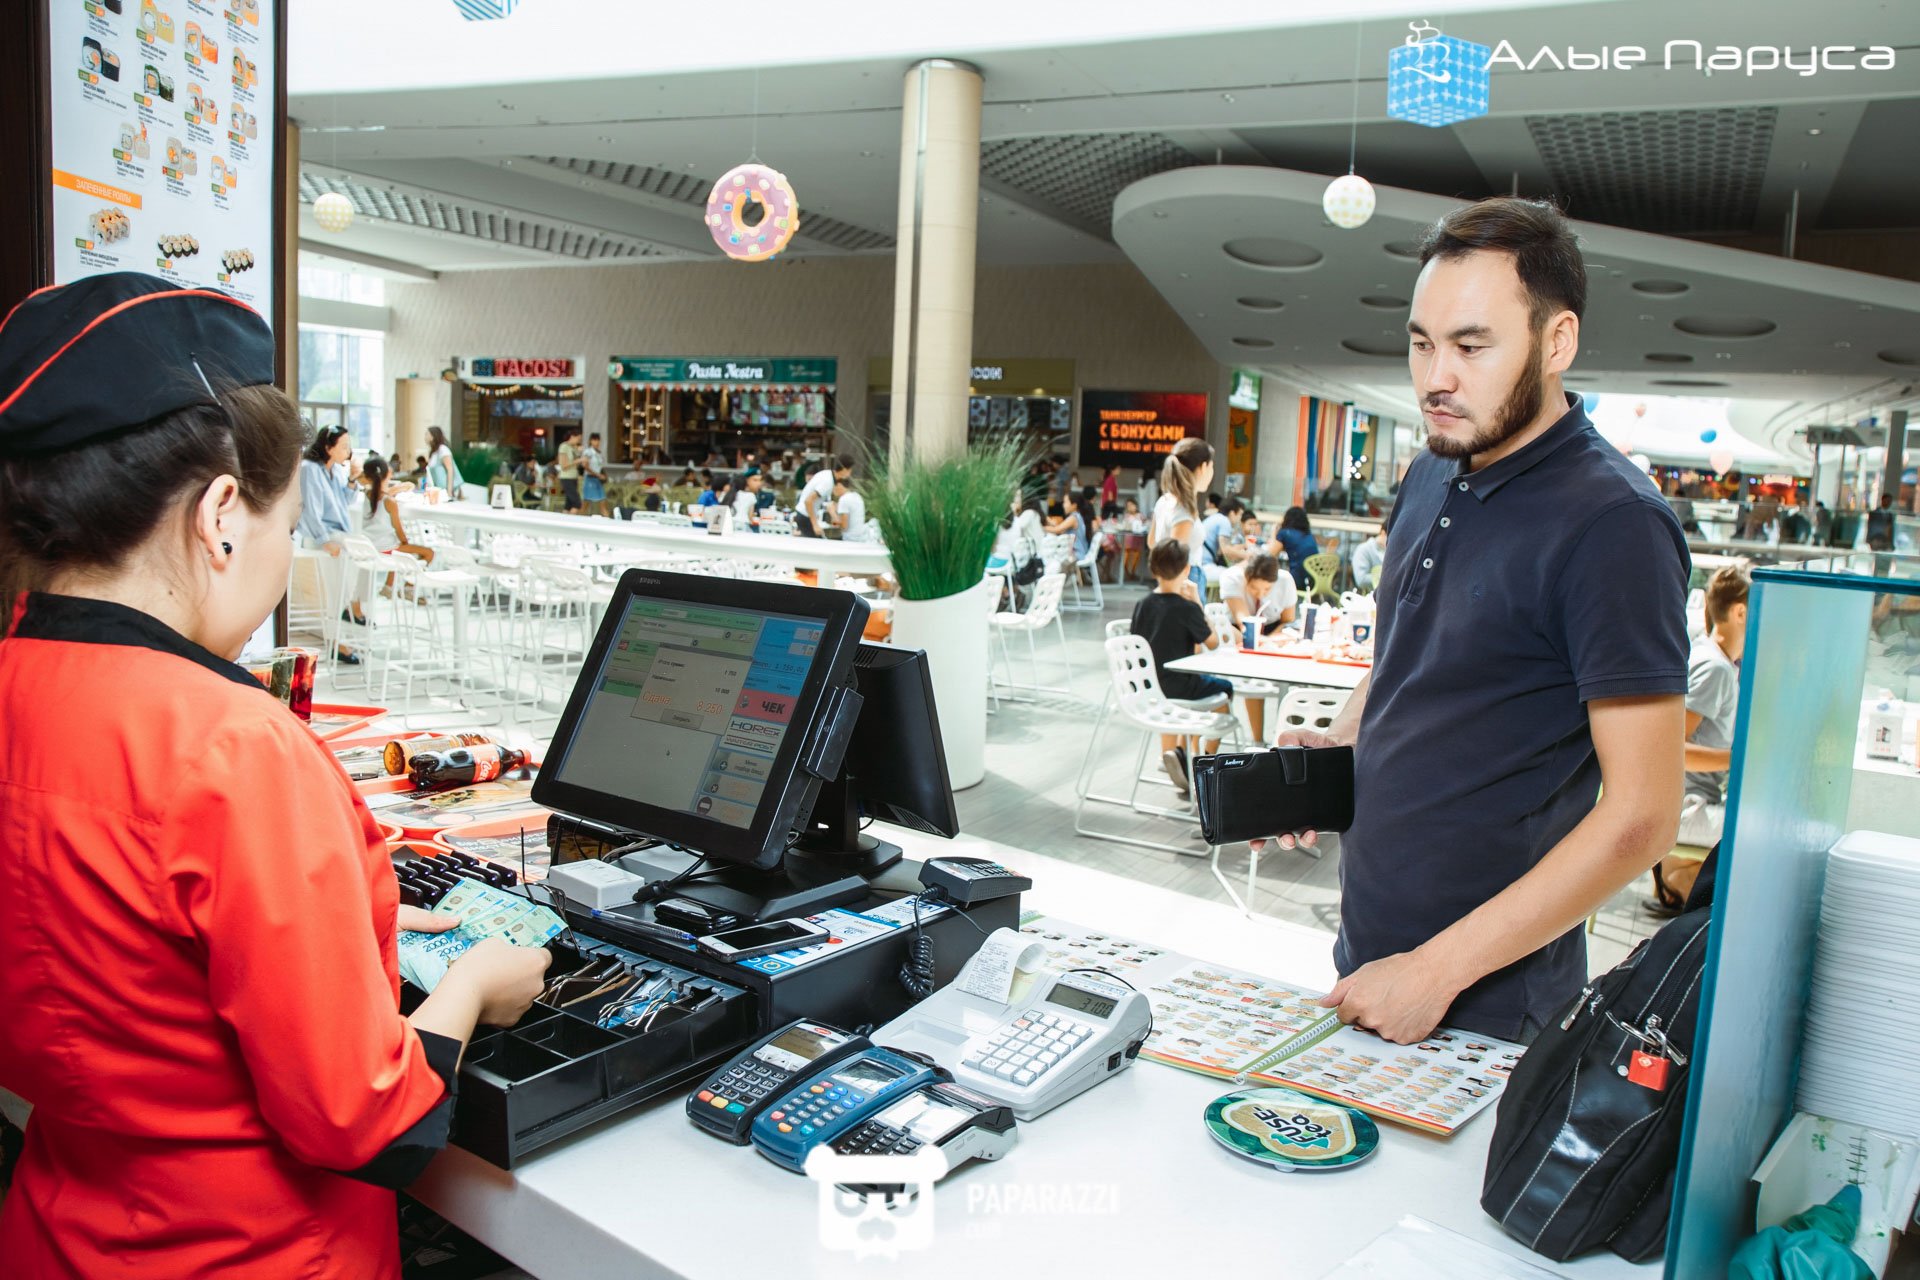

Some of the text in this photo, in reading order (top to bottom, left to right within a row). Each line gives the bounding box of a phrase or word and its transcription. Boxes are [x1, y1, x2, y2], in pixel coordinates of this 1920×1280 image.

[494, 358, 570, 377] TACOS!
[689, 362, 722, 380] Pasta
[724, 362, 763, 380] Nostra
[1110, 423, 1185, 440] БОНУСАМИ
[762, 700, 785, 714] ЧЕК
[423, 938, 448, 953] 2000
[440, 944, 464, 958] 2000
[1291, 1114, 1332, 1138] tea
